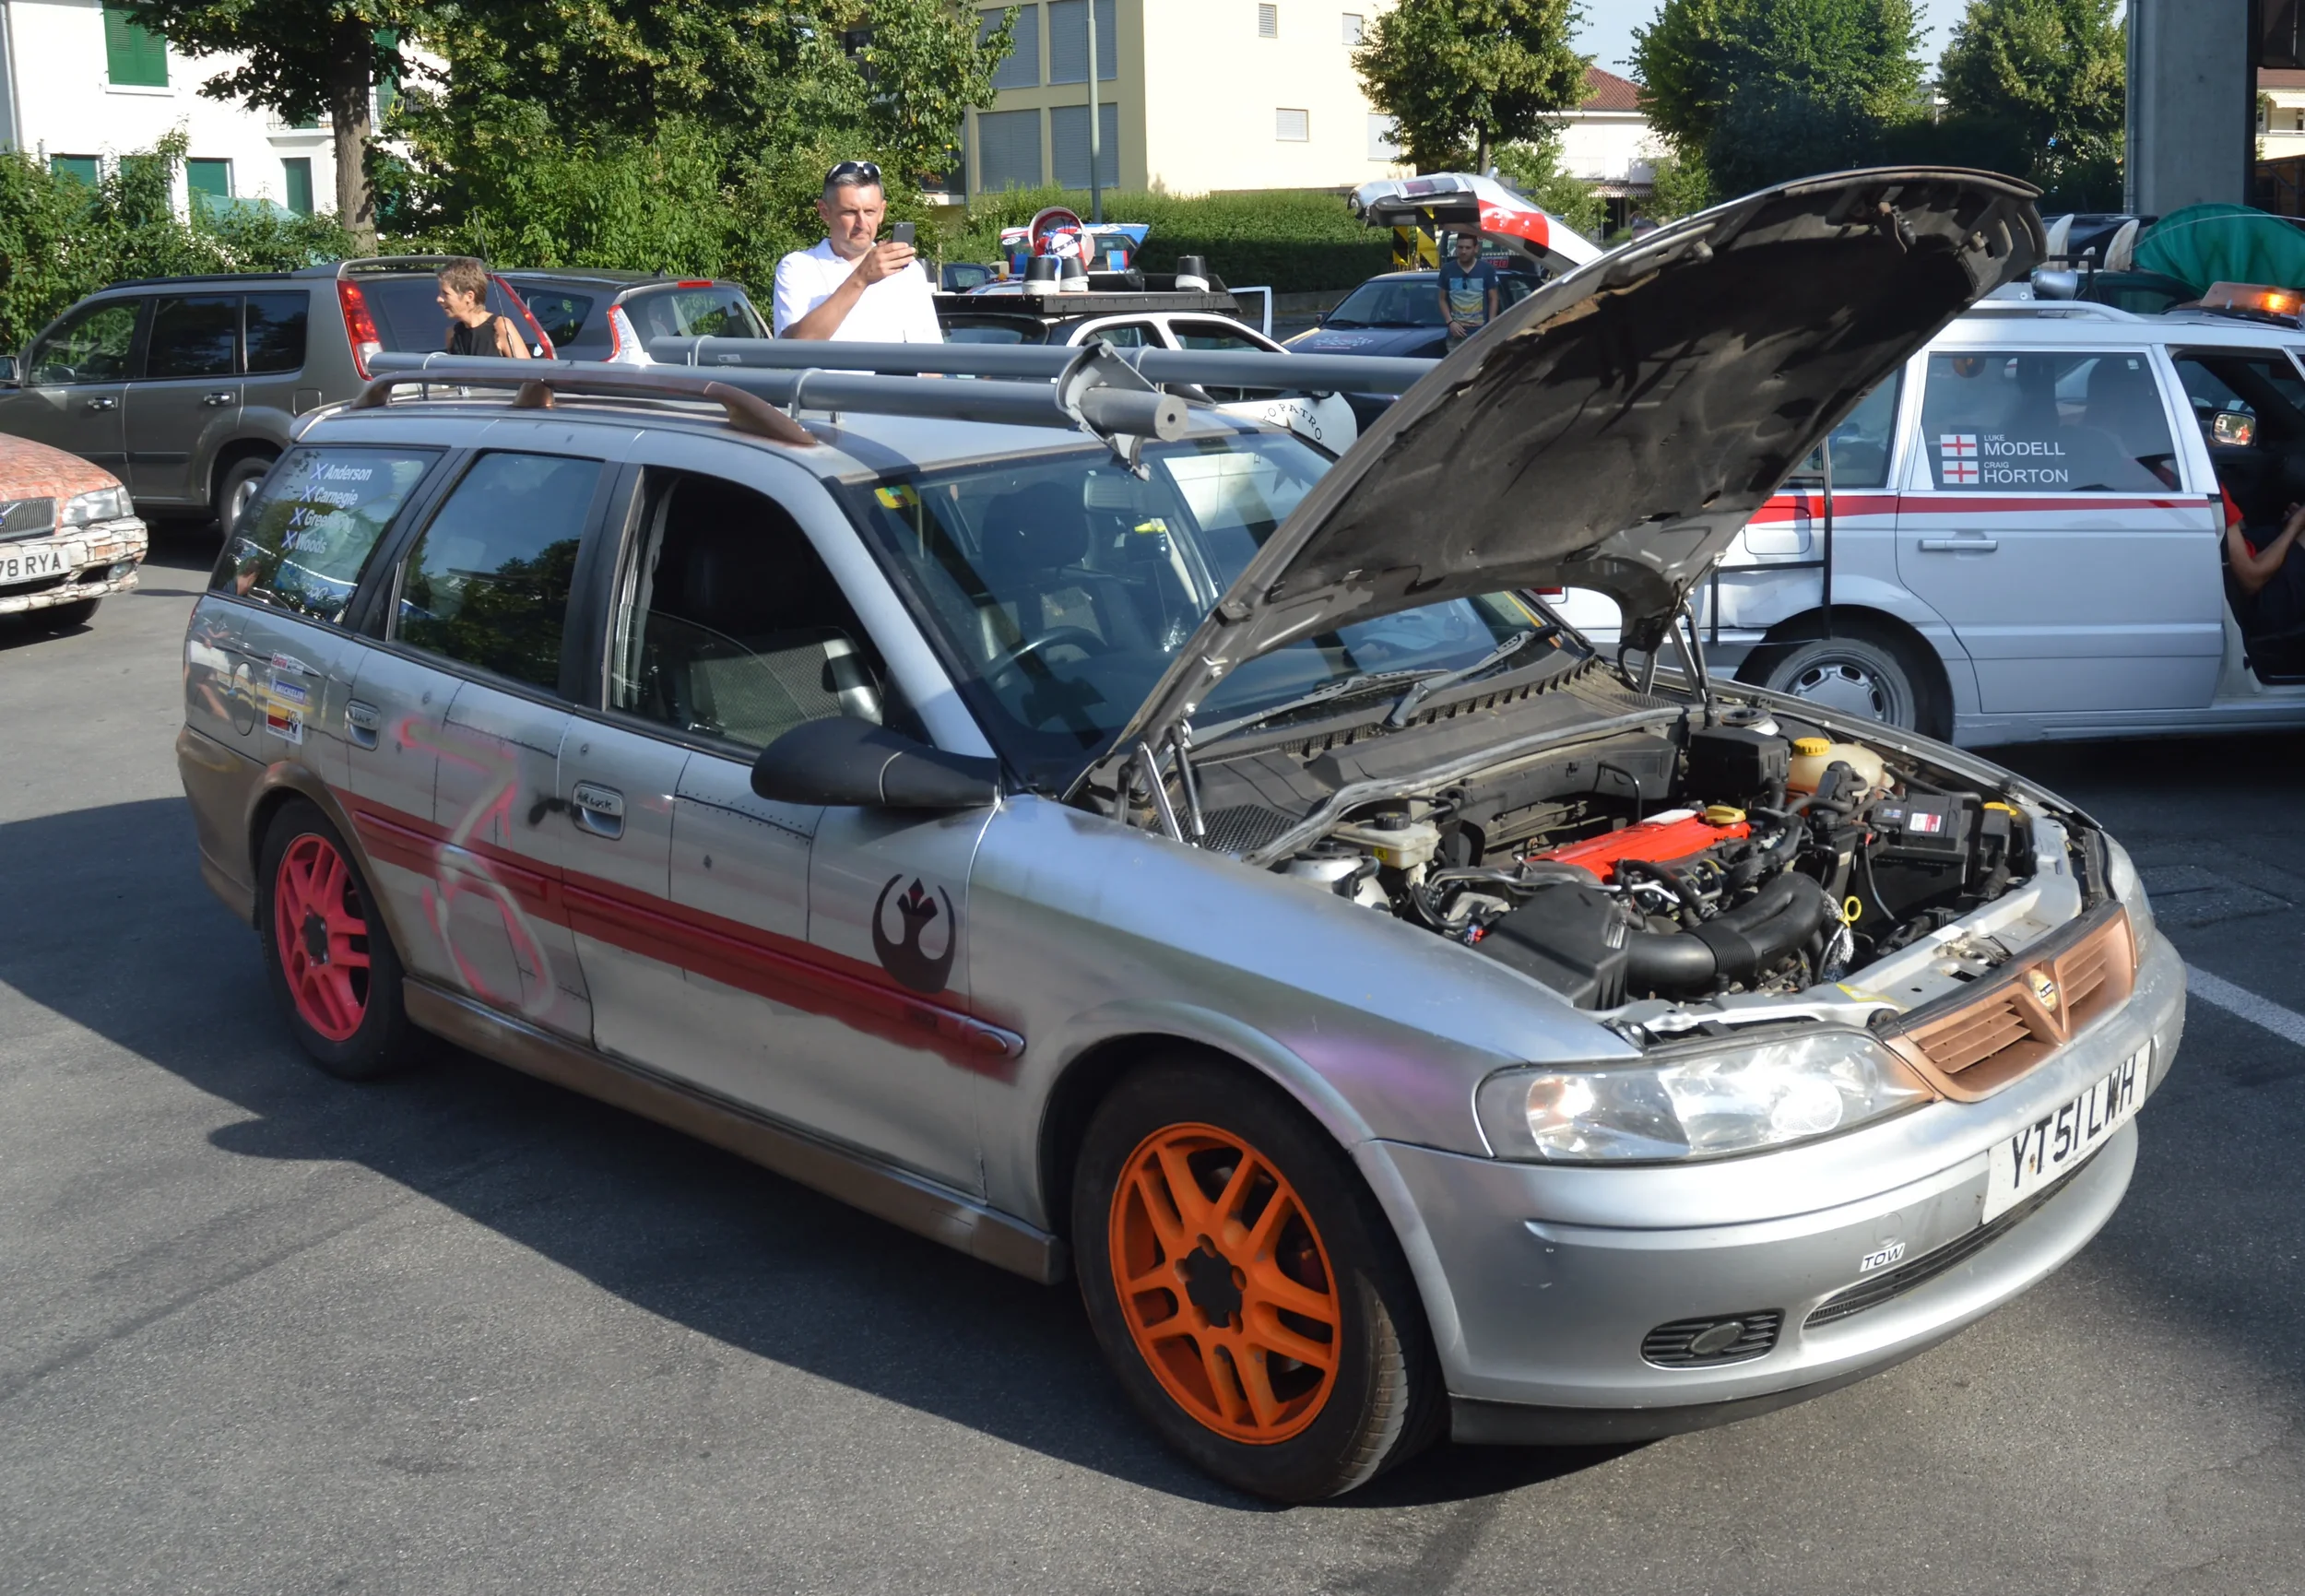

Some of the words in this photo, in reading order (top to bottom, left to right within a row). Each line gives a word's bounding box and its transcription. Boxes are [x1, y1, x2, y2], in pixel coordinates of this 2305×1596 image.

[1984, 442, 2066, 455] MODELL
[324, 465, 372, 480] Anderson
[1984, 469, 2068, 483] HORTON
[314, 487, 359, 509] Carnegie
[296, 533, 327, 553] Woods
[26, 552, 61, 574] RYA
[1864, 1246, 1904, 1270] TOW
